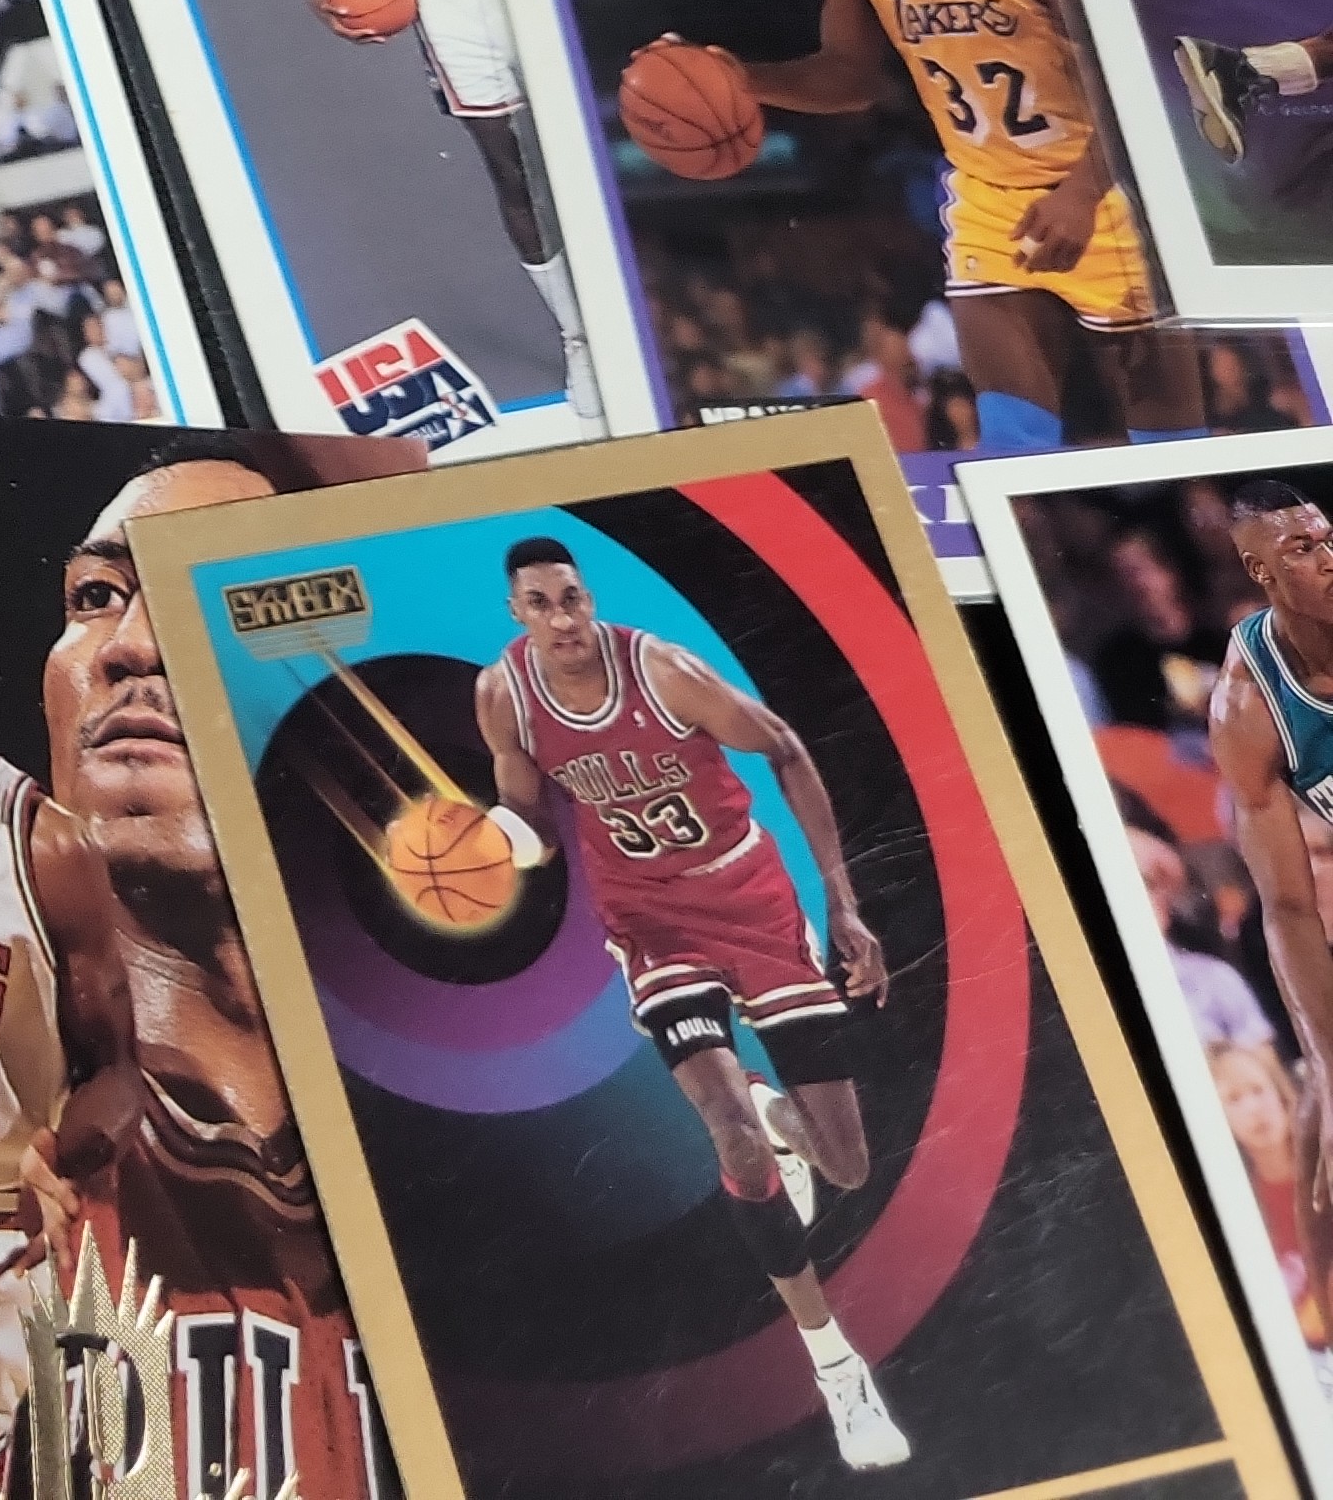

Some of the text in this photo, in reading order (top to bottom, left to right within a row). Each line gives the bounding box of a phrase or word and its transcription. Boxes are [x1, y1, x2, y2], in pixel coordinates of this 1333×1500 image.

[917, 58, 1066, 148] 32
[317, 329, 472, 436] USA
[598, 791, 710, 859] 33
